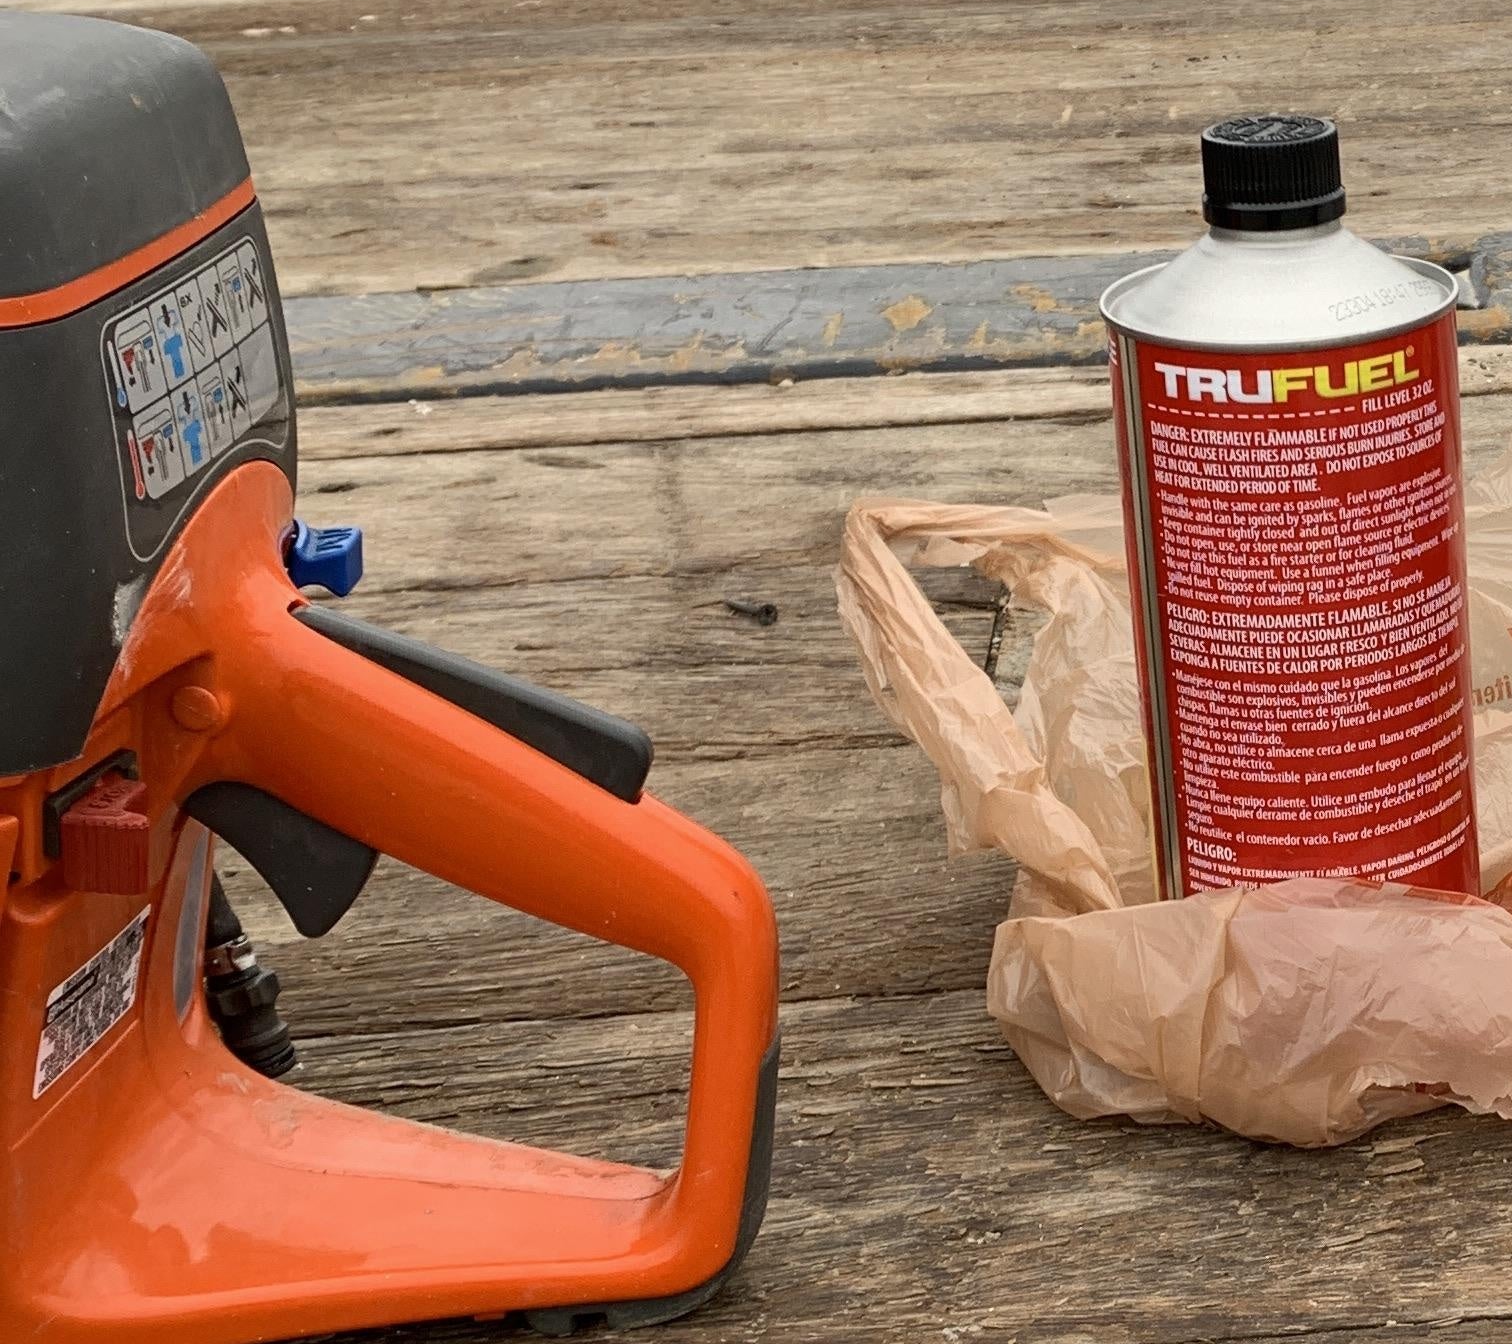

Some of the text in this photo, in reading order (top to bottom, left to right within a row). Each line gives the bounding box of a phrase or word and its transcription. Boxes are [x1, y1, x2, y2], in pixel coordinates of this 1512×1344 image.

[1362, 378, 1434, 414] FILL LEVEL 32 OZ.
[1150, 419, 1190, 442] DANGER:
[1189, 427, 1253, 446] EXTREMELY
[1253, 427, 1327, 446] FLAMMABLE
[1327, 425, 1338, 441] IF
[1338, 422, 1359, 440] NOT
[1359, 416, 1385, 436] USED
[1384, 404, 1423, 431] PROPERLY
[1151, 436, 1170, 454] FUEL
[1169, 441, 1188, 458] CAN
[1187, 444, 1217, 461] CAUSE
[1217, 447, 1250, 462] FLASH
[1250, 448, 1279, 463] FIRES
[1279, 446, 1303, 462] AND
[1303, 441, 1346, 460] SERIOUS
[1346, 436, 1374, 455] BURN
[1433, 410, 1445, 430] AND
[1152, 452, 1167, 469] USE
[1166, 456, 1177, 472] IN
[1177, 458, 1202, 477] COOL,
[1202, 462, 1228, 478] WELL
[1228, 464, 1289, 479] VENTILATED
[1324, 458, 1341, 474] DO
[1341, 455, 1361, 472] NOT
[1361, 447, 1395, 468] EXPOSE
[1395, 443, 1406, 460] TO
[1434, 428, 1442, 445] OF
[1154, 467, 1321, 494] HEAT FOR EXTENDED PERIOD OF TIME.
[1164, 531, 1414, 566] Do not use this fuel as a fire starter or for cleaning fluid.
[1166, 565, 1393, 595] spilled fuel. Dispose of wiping rag in a safe place.
[1167, 567, 1424, 609] Do not reuse empty container. Please dispose of properly.
[1166, 600, 1211, 625] PELIGRO:
[1210, 610, 1326, 629] EXTREMADAMENTE
[1326, 599, 1391, 627] FLAMABLE,
[1391, 596, 1402, 613] SI
[1401, 591, 1415, 610] NO
[1415, 587, 1425, 605] SE
[1169, 645, 1210, 669] EXPONGA
[1210, 656, 1219, 671] A
[1218, 657, 1265, 674] FUENTES
[1265, 660, 1281, 674] DE
[1281, 658, 1318, 674] CALOR
[1318, 655, 1343, 672] POR
[1343, 644, 1394, 669] PERIODOS
[1394, 633, 1427, 658] LARGOS
[1427, 628, 1437, 646] DE
[1179, 719, 1284, 745] cuando no sea utilizado.
[1186, 835, 1237, 863] PELIGRO:
